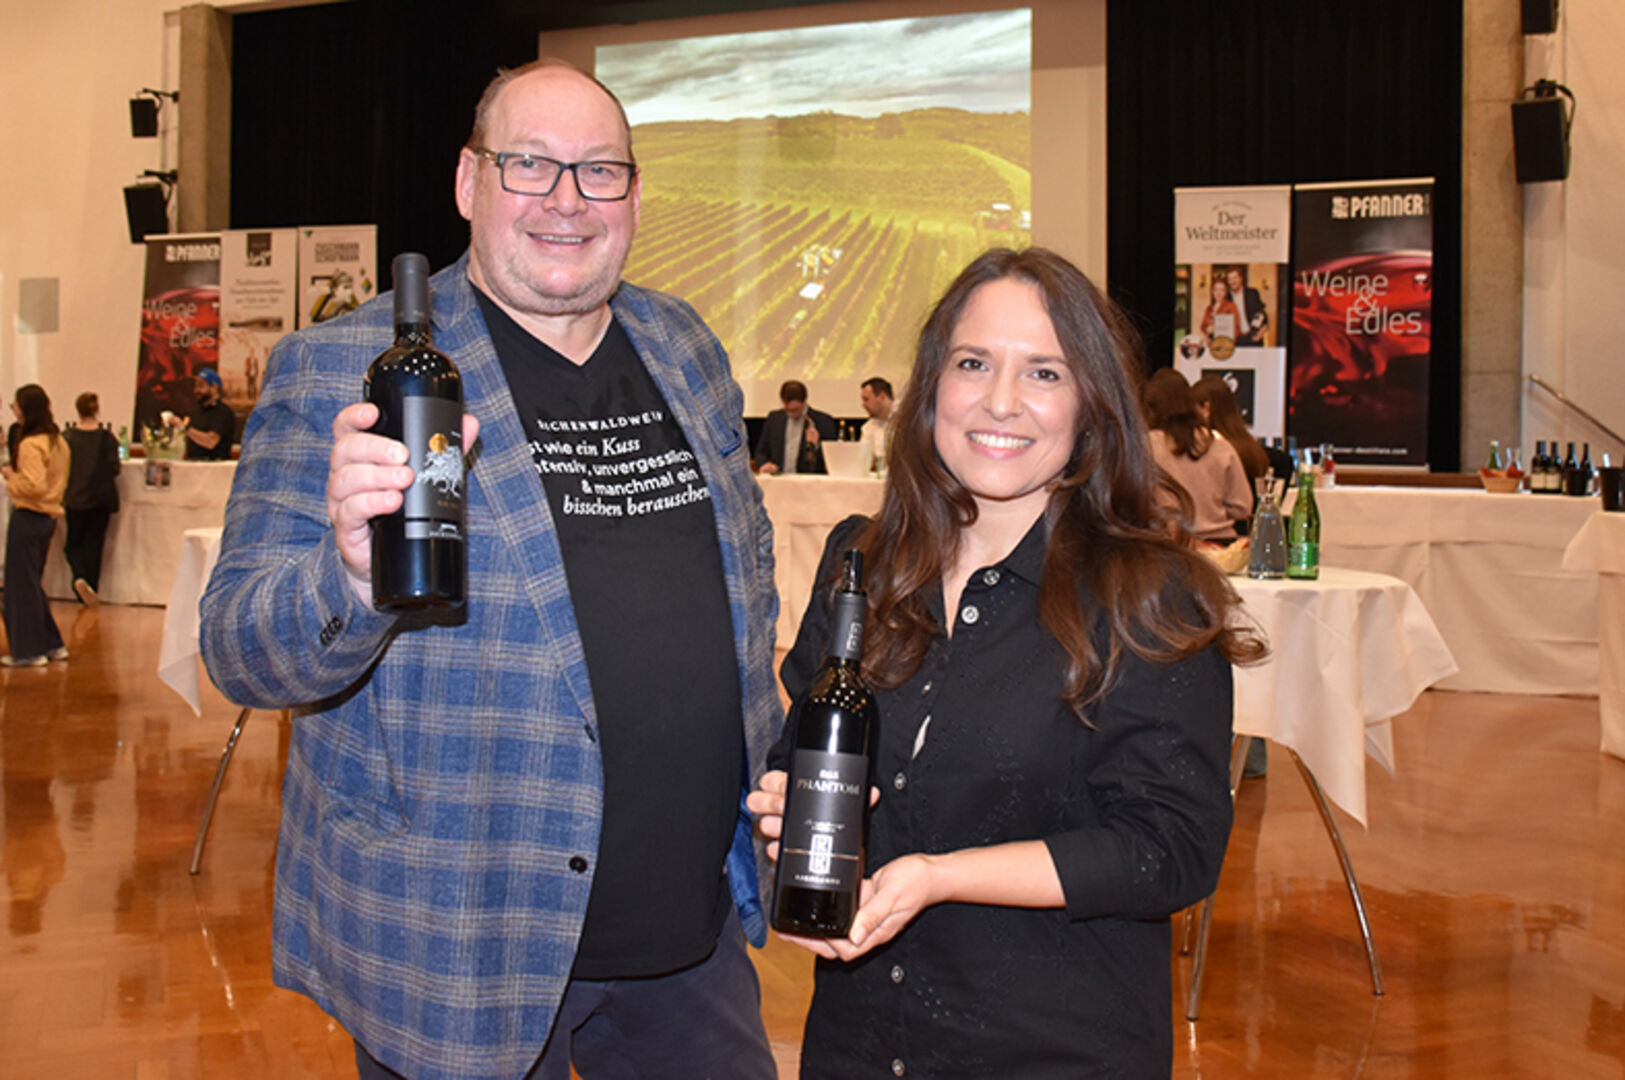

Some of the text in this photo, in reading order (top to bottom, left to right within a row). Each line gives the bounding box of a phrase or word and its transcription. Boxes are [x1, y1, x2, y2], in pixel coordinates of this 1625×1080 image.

[1217, 210, 1247, 226] Der
[1350, 193, 1424, 218] PFANNER
[1185, 225, 1278, 241] Weltmeister
[1300, 270, 1389, 297] Weine
[1345, 306, 1423, 335] Edles
[528, 436, 641, 457] st wie ein Kuss
[534, 449, 694, 477] ntensiv, unvergesslich
[581, 467, 699, 496] & manchmal ein
[563, 483, 711, 517] bisschen berauschen
[797, 778, 860, 795] PHANTOM
